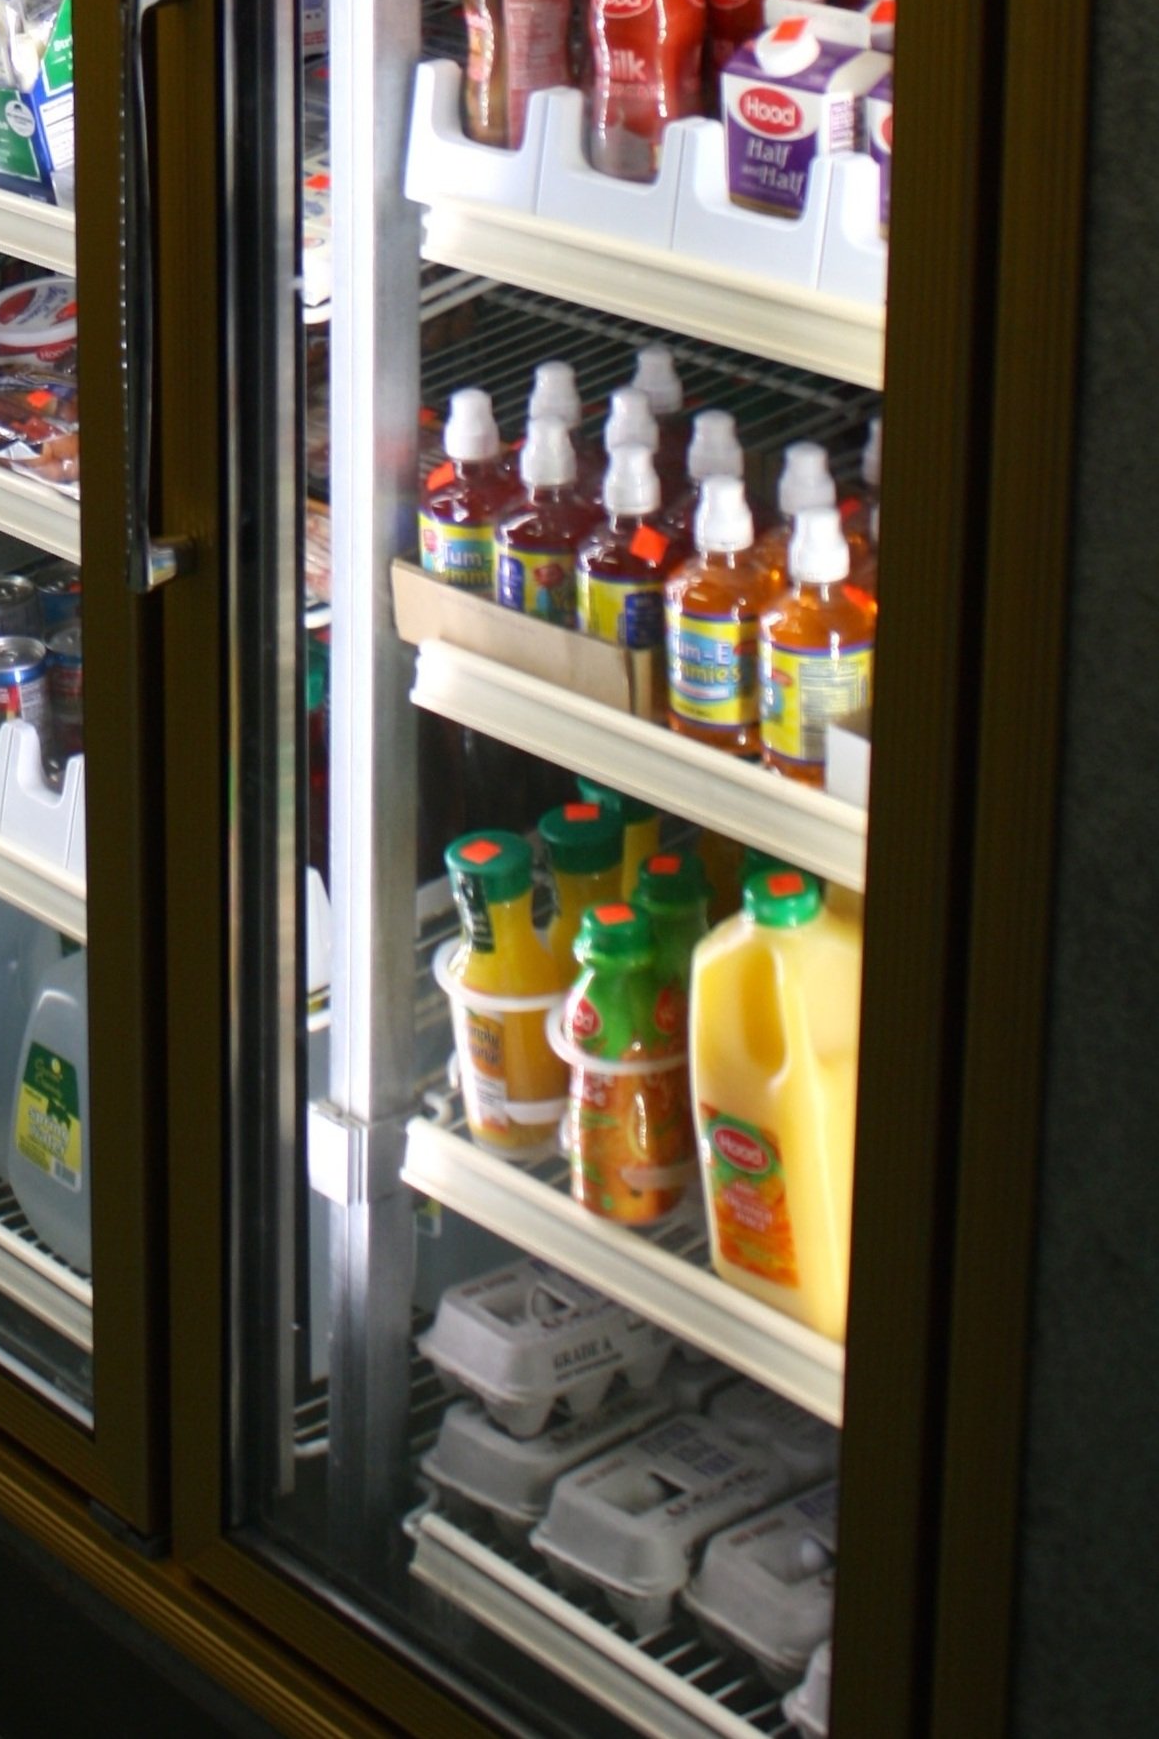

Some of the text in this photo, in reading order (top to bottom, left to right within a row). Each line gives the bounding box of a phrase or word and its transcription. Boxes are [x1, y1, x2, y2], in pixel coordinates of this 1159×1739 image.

[611, 49, 646, 80] ilk
[743, 94, 797, 129] Hood
[746, 139, 792, 169] Half
[760, 163, 806, 197] Half
[554, 1340, 598, 1370] GRADE
[603, 1336, 614, 1351] A
